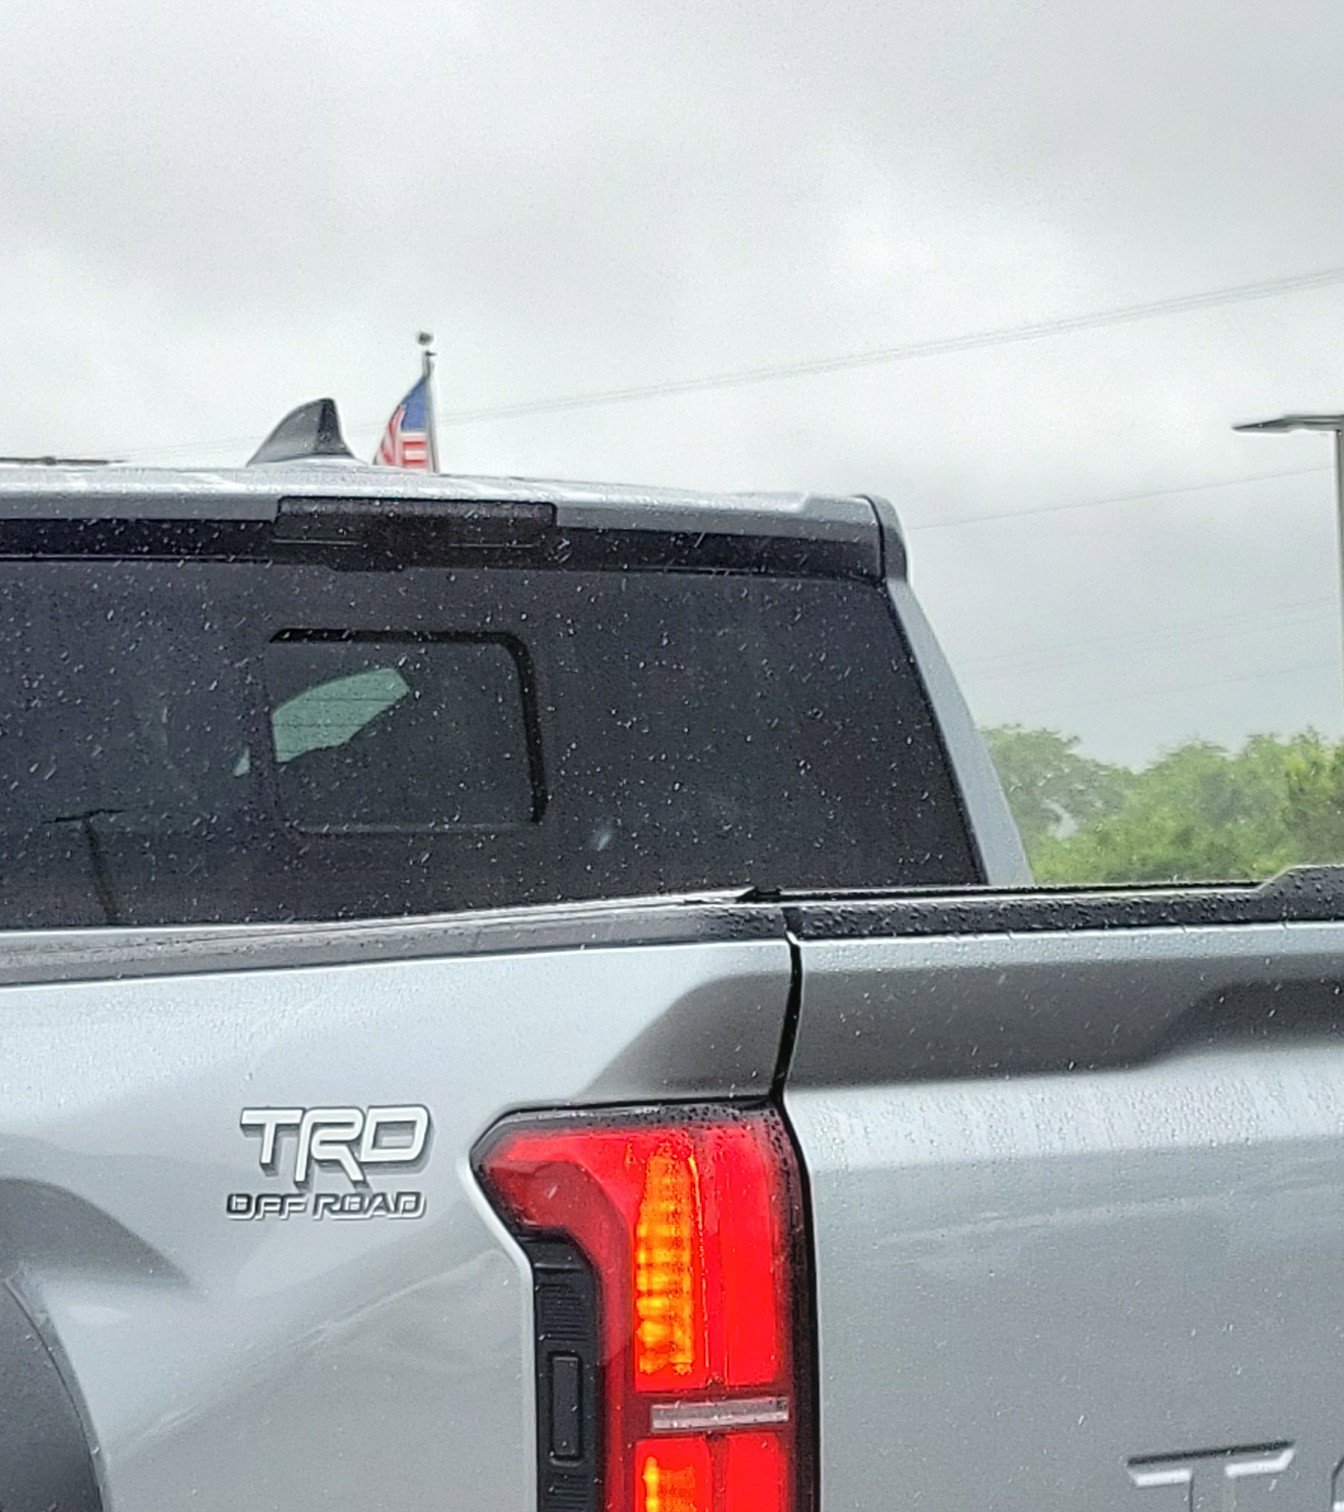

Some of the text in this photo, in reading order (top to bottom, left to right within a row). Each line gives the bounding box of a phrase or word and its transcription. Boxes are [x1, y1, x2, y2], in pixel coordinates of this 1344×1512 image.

[240, 1104, 432, 1190] TRD
[226, 1191, 426, 1220] OFF ROAD
